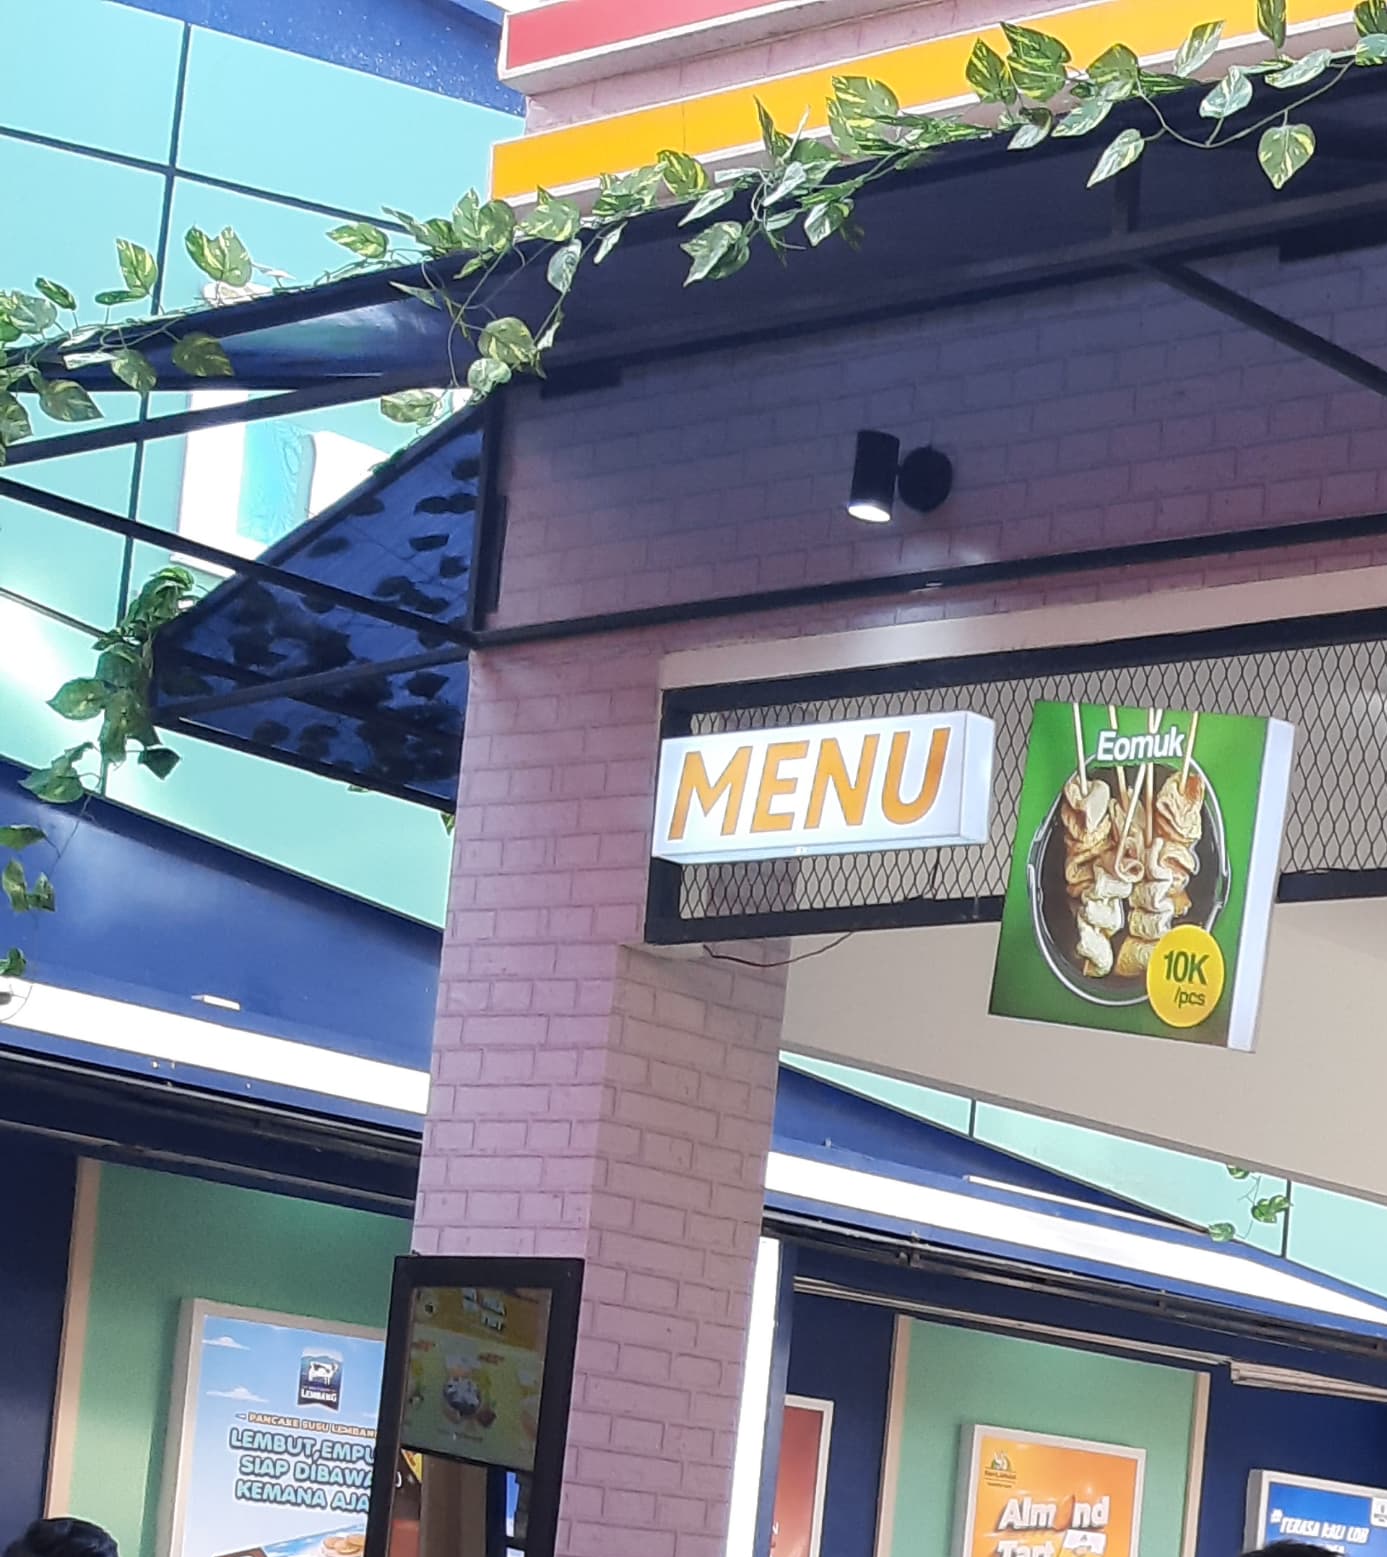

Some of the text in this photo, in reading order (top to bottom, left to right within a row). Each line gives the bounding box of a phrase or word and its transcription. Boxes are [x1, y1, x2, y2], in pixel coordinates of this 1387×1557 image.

[1096, 727, 1187, 762] Eomuk
[668, 727, 952, 841] MENU
[1164, 950, 1208, 986] 10K
[1174, 986, 1206, 1009] /pcs
[331, 1424, 377, 1438] LEMBAN
[240, 1455, 290, 1479] SIAP
[235, 1479, 369, 1513] KEMANA AJA
